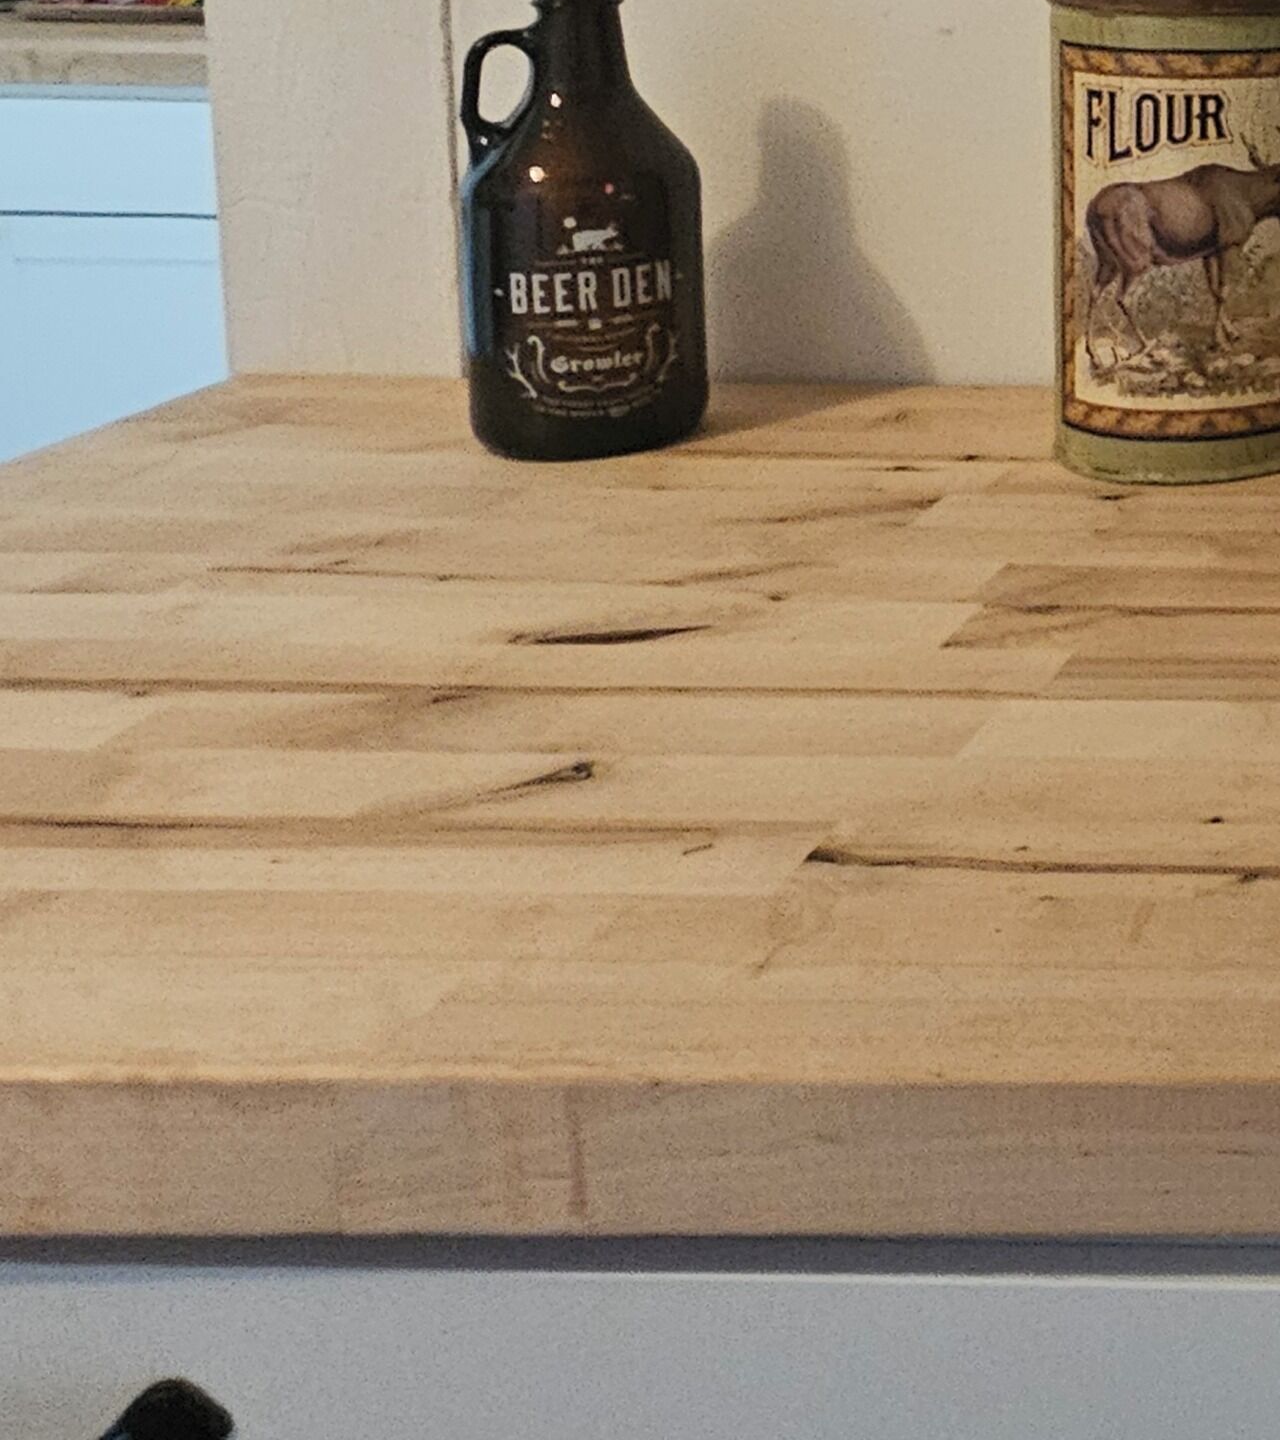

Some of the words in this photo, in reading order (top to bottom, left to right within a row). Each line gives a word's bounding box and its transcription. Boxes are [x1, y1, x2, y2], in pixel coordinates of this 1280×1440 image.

[1086, 89, 1227, 162] FLOUR
[509, 271, 598, 314] BEER
[611, 259, 672, 308] DEN
[549, 350, 643, 373] Growler
